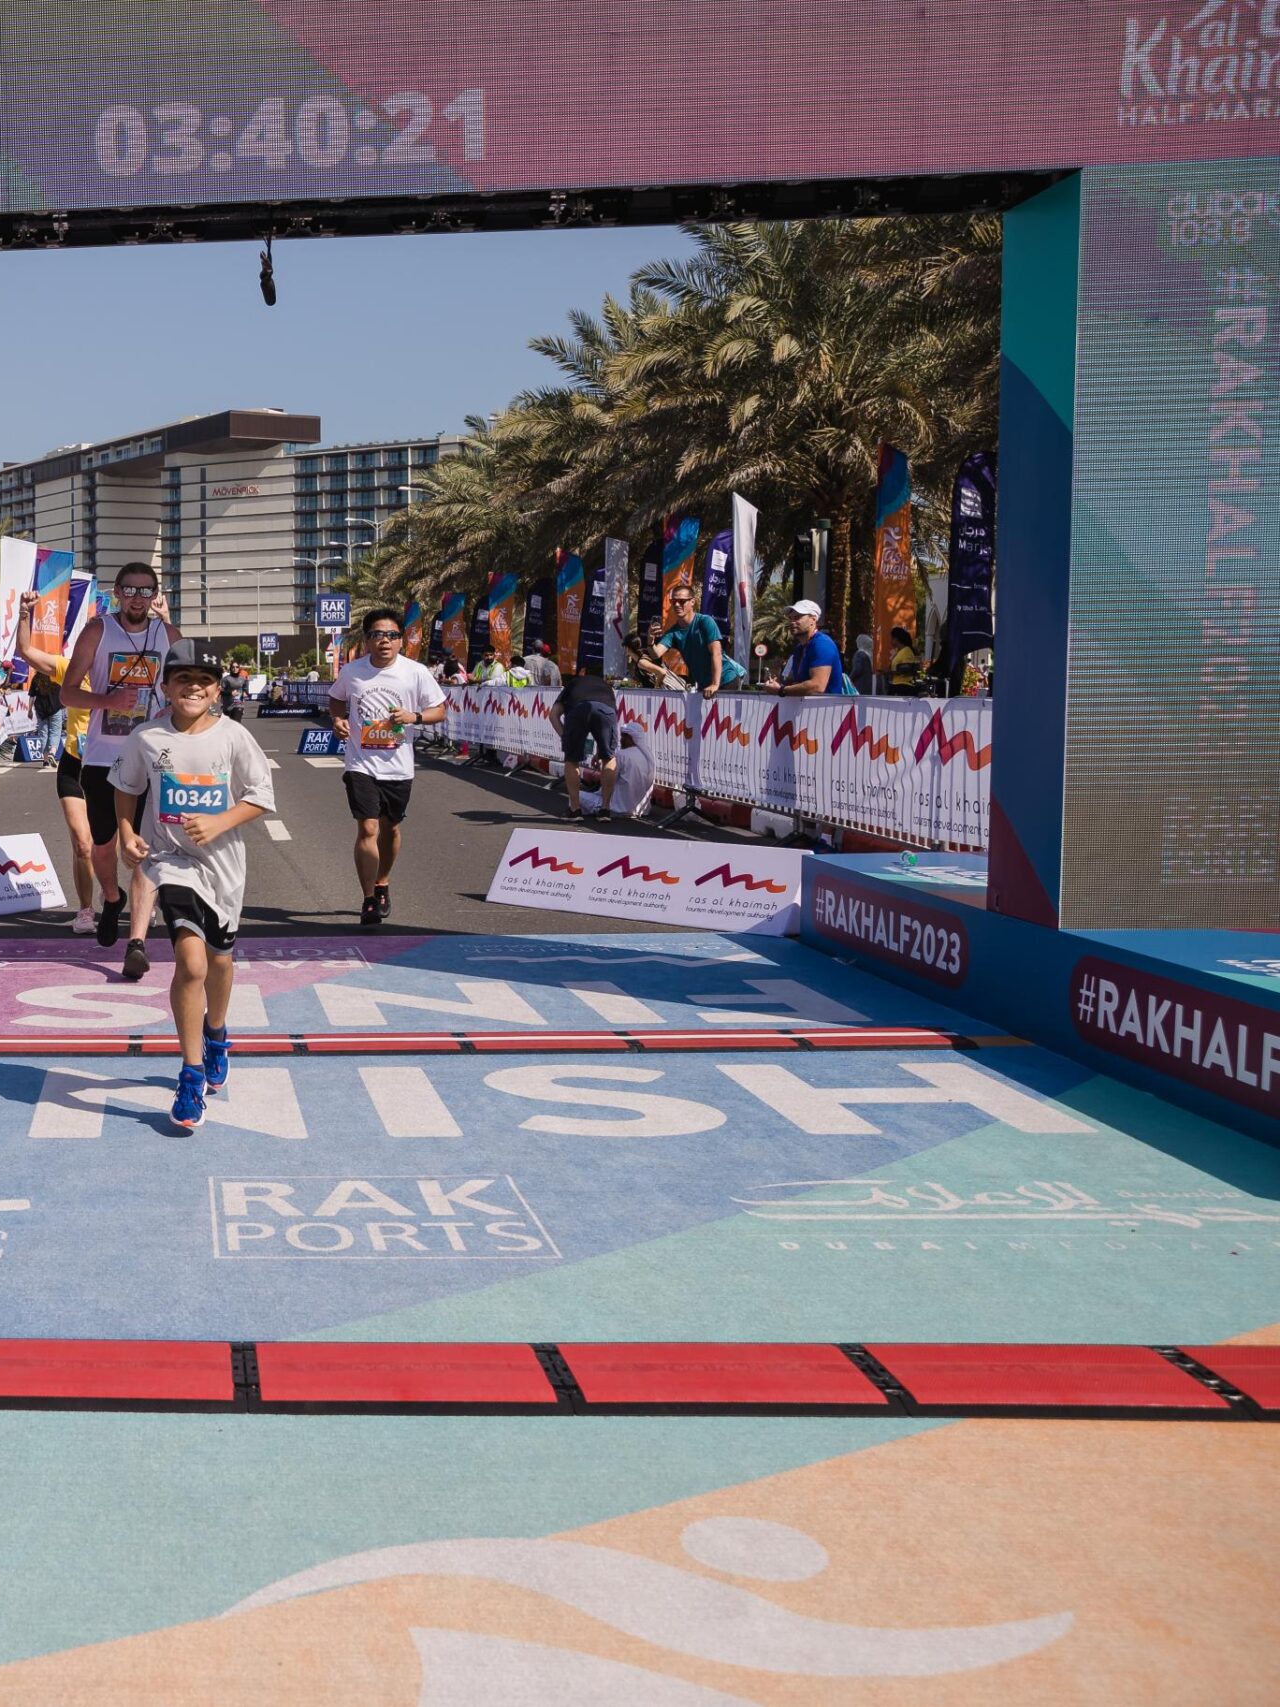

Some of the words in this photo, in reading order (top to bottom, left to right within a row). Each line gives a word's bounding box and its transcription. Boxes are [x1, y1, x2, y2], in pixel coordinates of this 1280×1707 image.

[96, 87, 488, 177] 03:40:21
[958, 539, 992, 555] Marj
[322, 600, 345, 611] RAK
[322, 611, 345, 621] PORTS
[307, 731, 331, 743] RAK
[368, 729, 394, 739] 6106
[27, 740, 41, 750] RA
[303, 742, 329, 753] PORTS
[166, 788, 223, 807] 10342
[913, 790, 930, 807] ras
[936, 790, 949, 810] al
[955, 791, 991, 815] khai
[6, 884, 15, 894] al
[15, 879, 52, 892] khaimah
[502, 875, 518, 883] ras
[522, 876, 532, 886] al
[536, 877, 576, 891] khaimah
[591, 886, 608, 895] ras
[612, 886, 623, 897] al
[627, 887, 671, 901] khaimah
[606, 896, 642, 908] development
[688, 894, 707, 904] ras
[712, 895, 724, 906] al
[729, 897, 778, 911] khaimah
[685, 905, 706, 914] tourism
[705, 907, 746, 919] development
[746, 912, 775, 922] authority
[815, 887, 962, 975] #RAKHALF2023
[221, 1180, 520, 1217] RAK
[225, 1222, 543, 1252] PORTS
[778, 1241, 981, 1251] DUBAI
